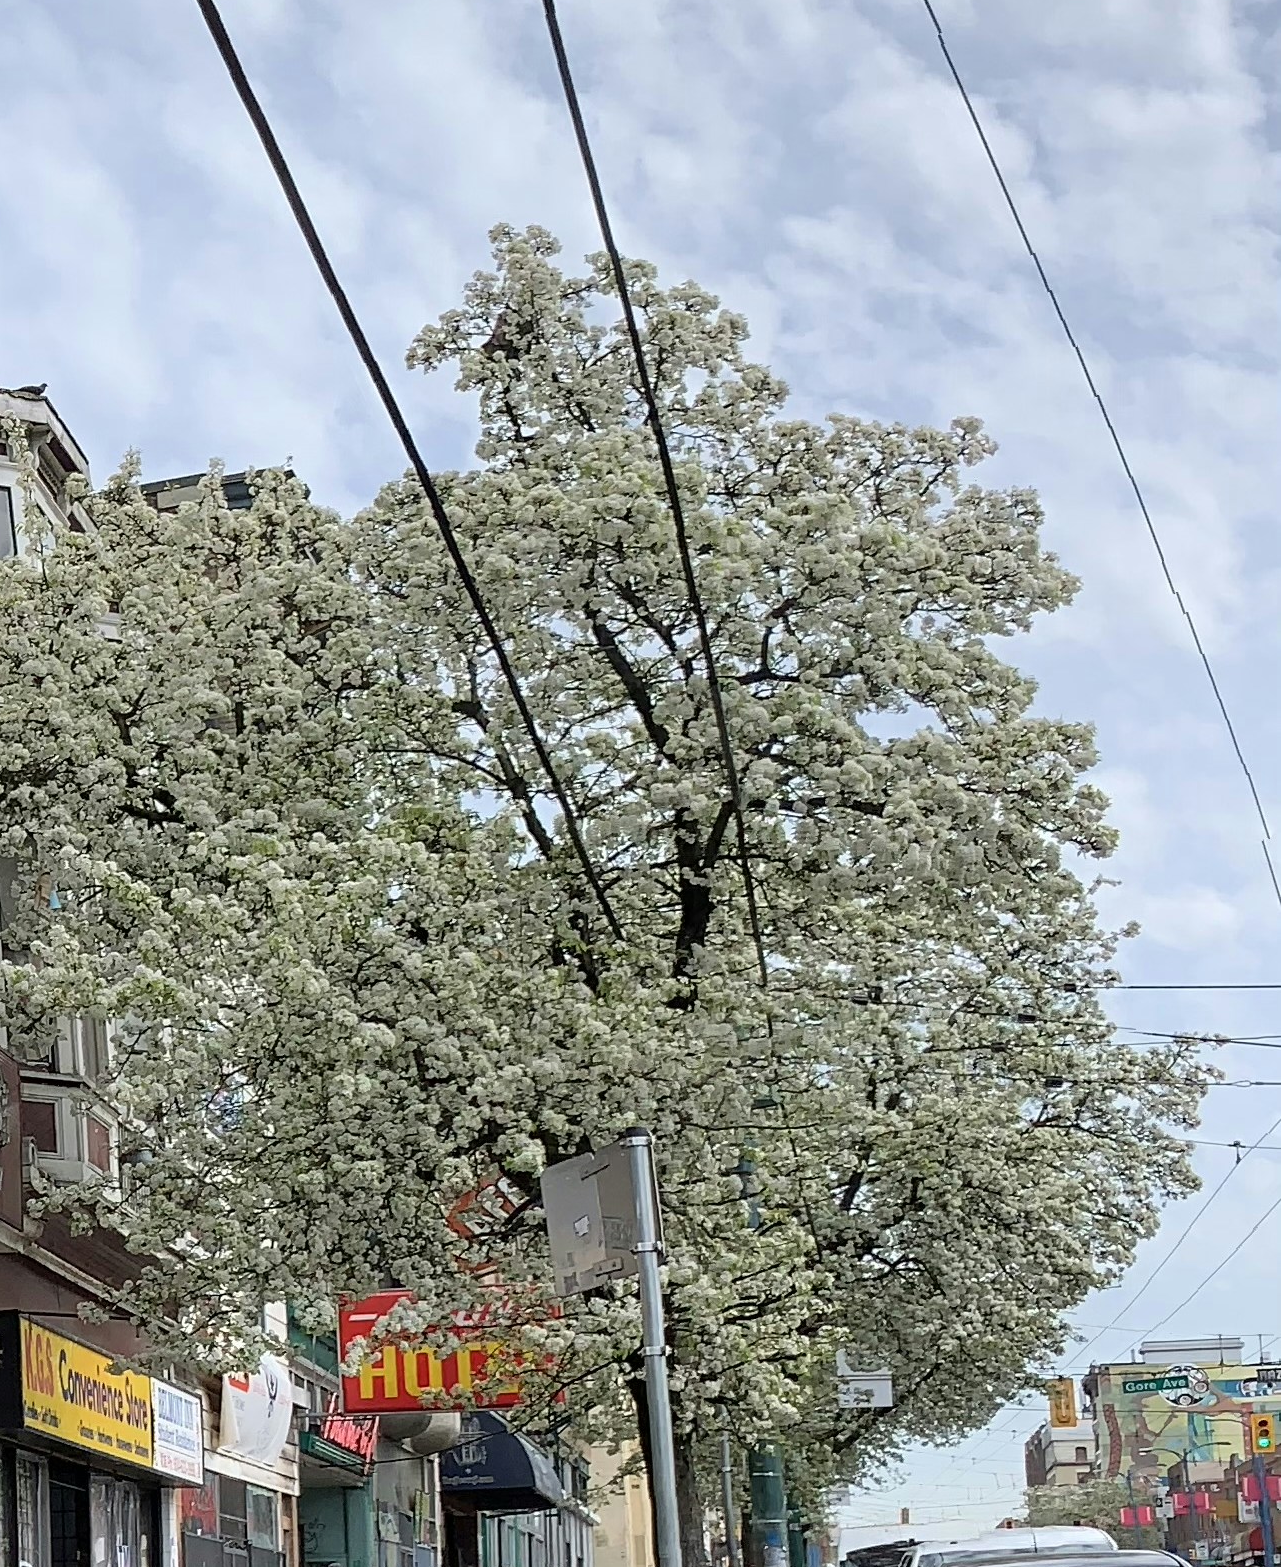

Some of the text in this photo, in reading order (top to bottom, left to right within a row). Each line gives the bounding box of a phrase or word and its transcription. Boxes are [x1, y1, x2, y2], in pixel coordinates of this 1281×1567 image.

[59, 1348, 124, 1423] Convenience
[124, 1376, 149, 1432] Store
[1125, 1378, 1186, 1392] Gore Ave
